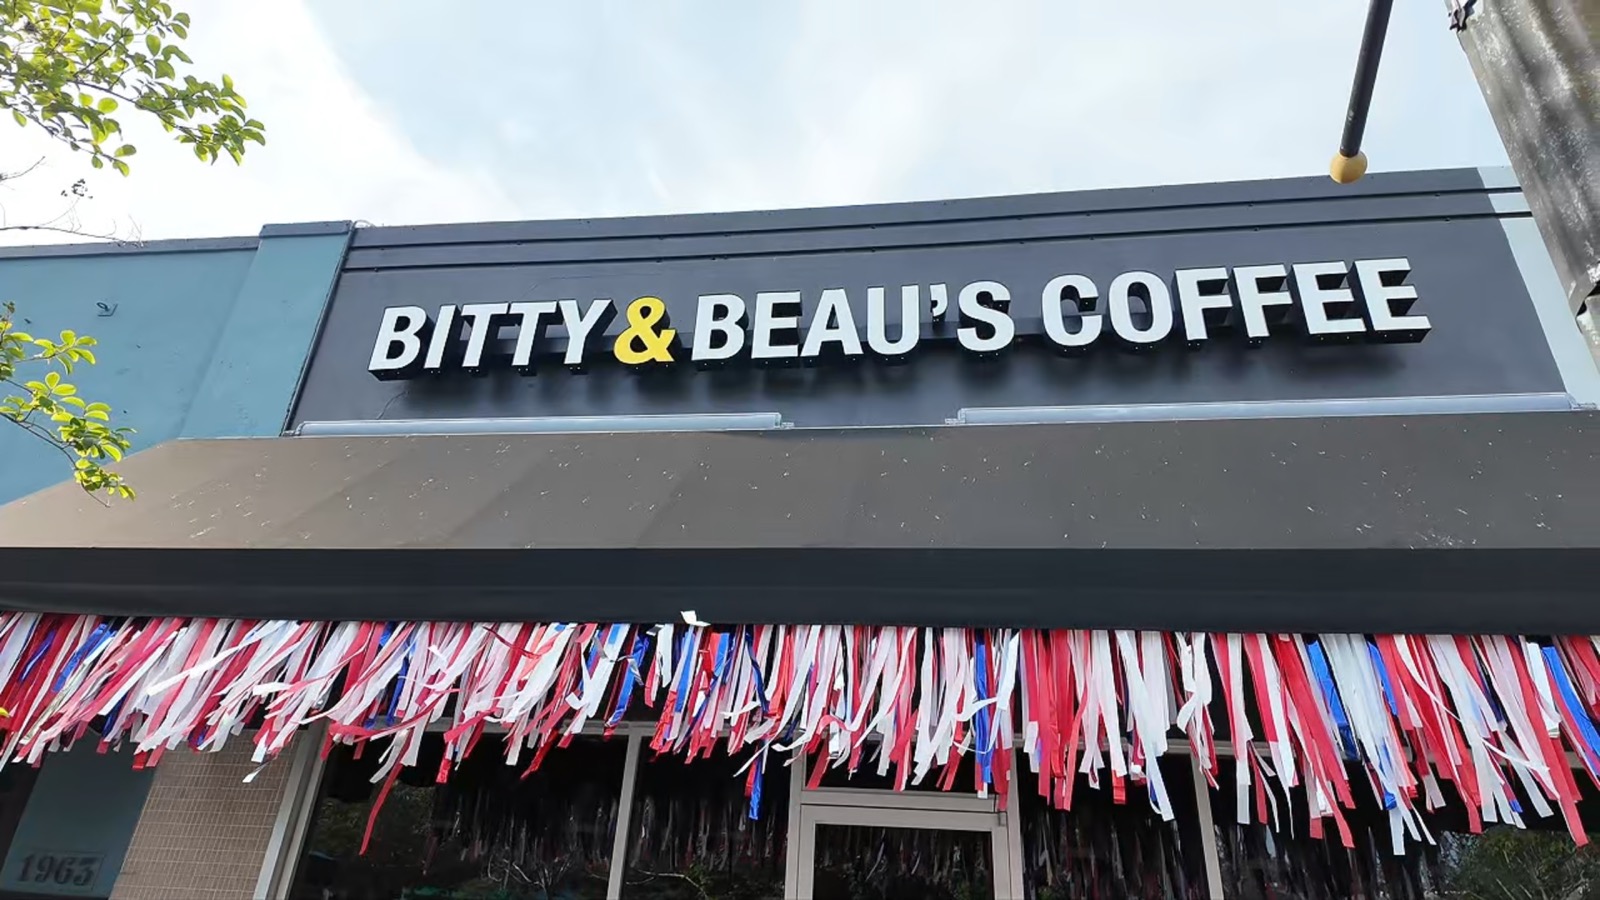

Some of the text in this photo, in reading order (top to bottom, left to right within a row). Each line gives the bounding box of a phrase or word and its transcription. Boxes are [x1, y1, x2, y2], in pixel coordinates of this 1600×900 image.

[368, 257, 1432, 372] BITTY & BEAU'S COFFEE
